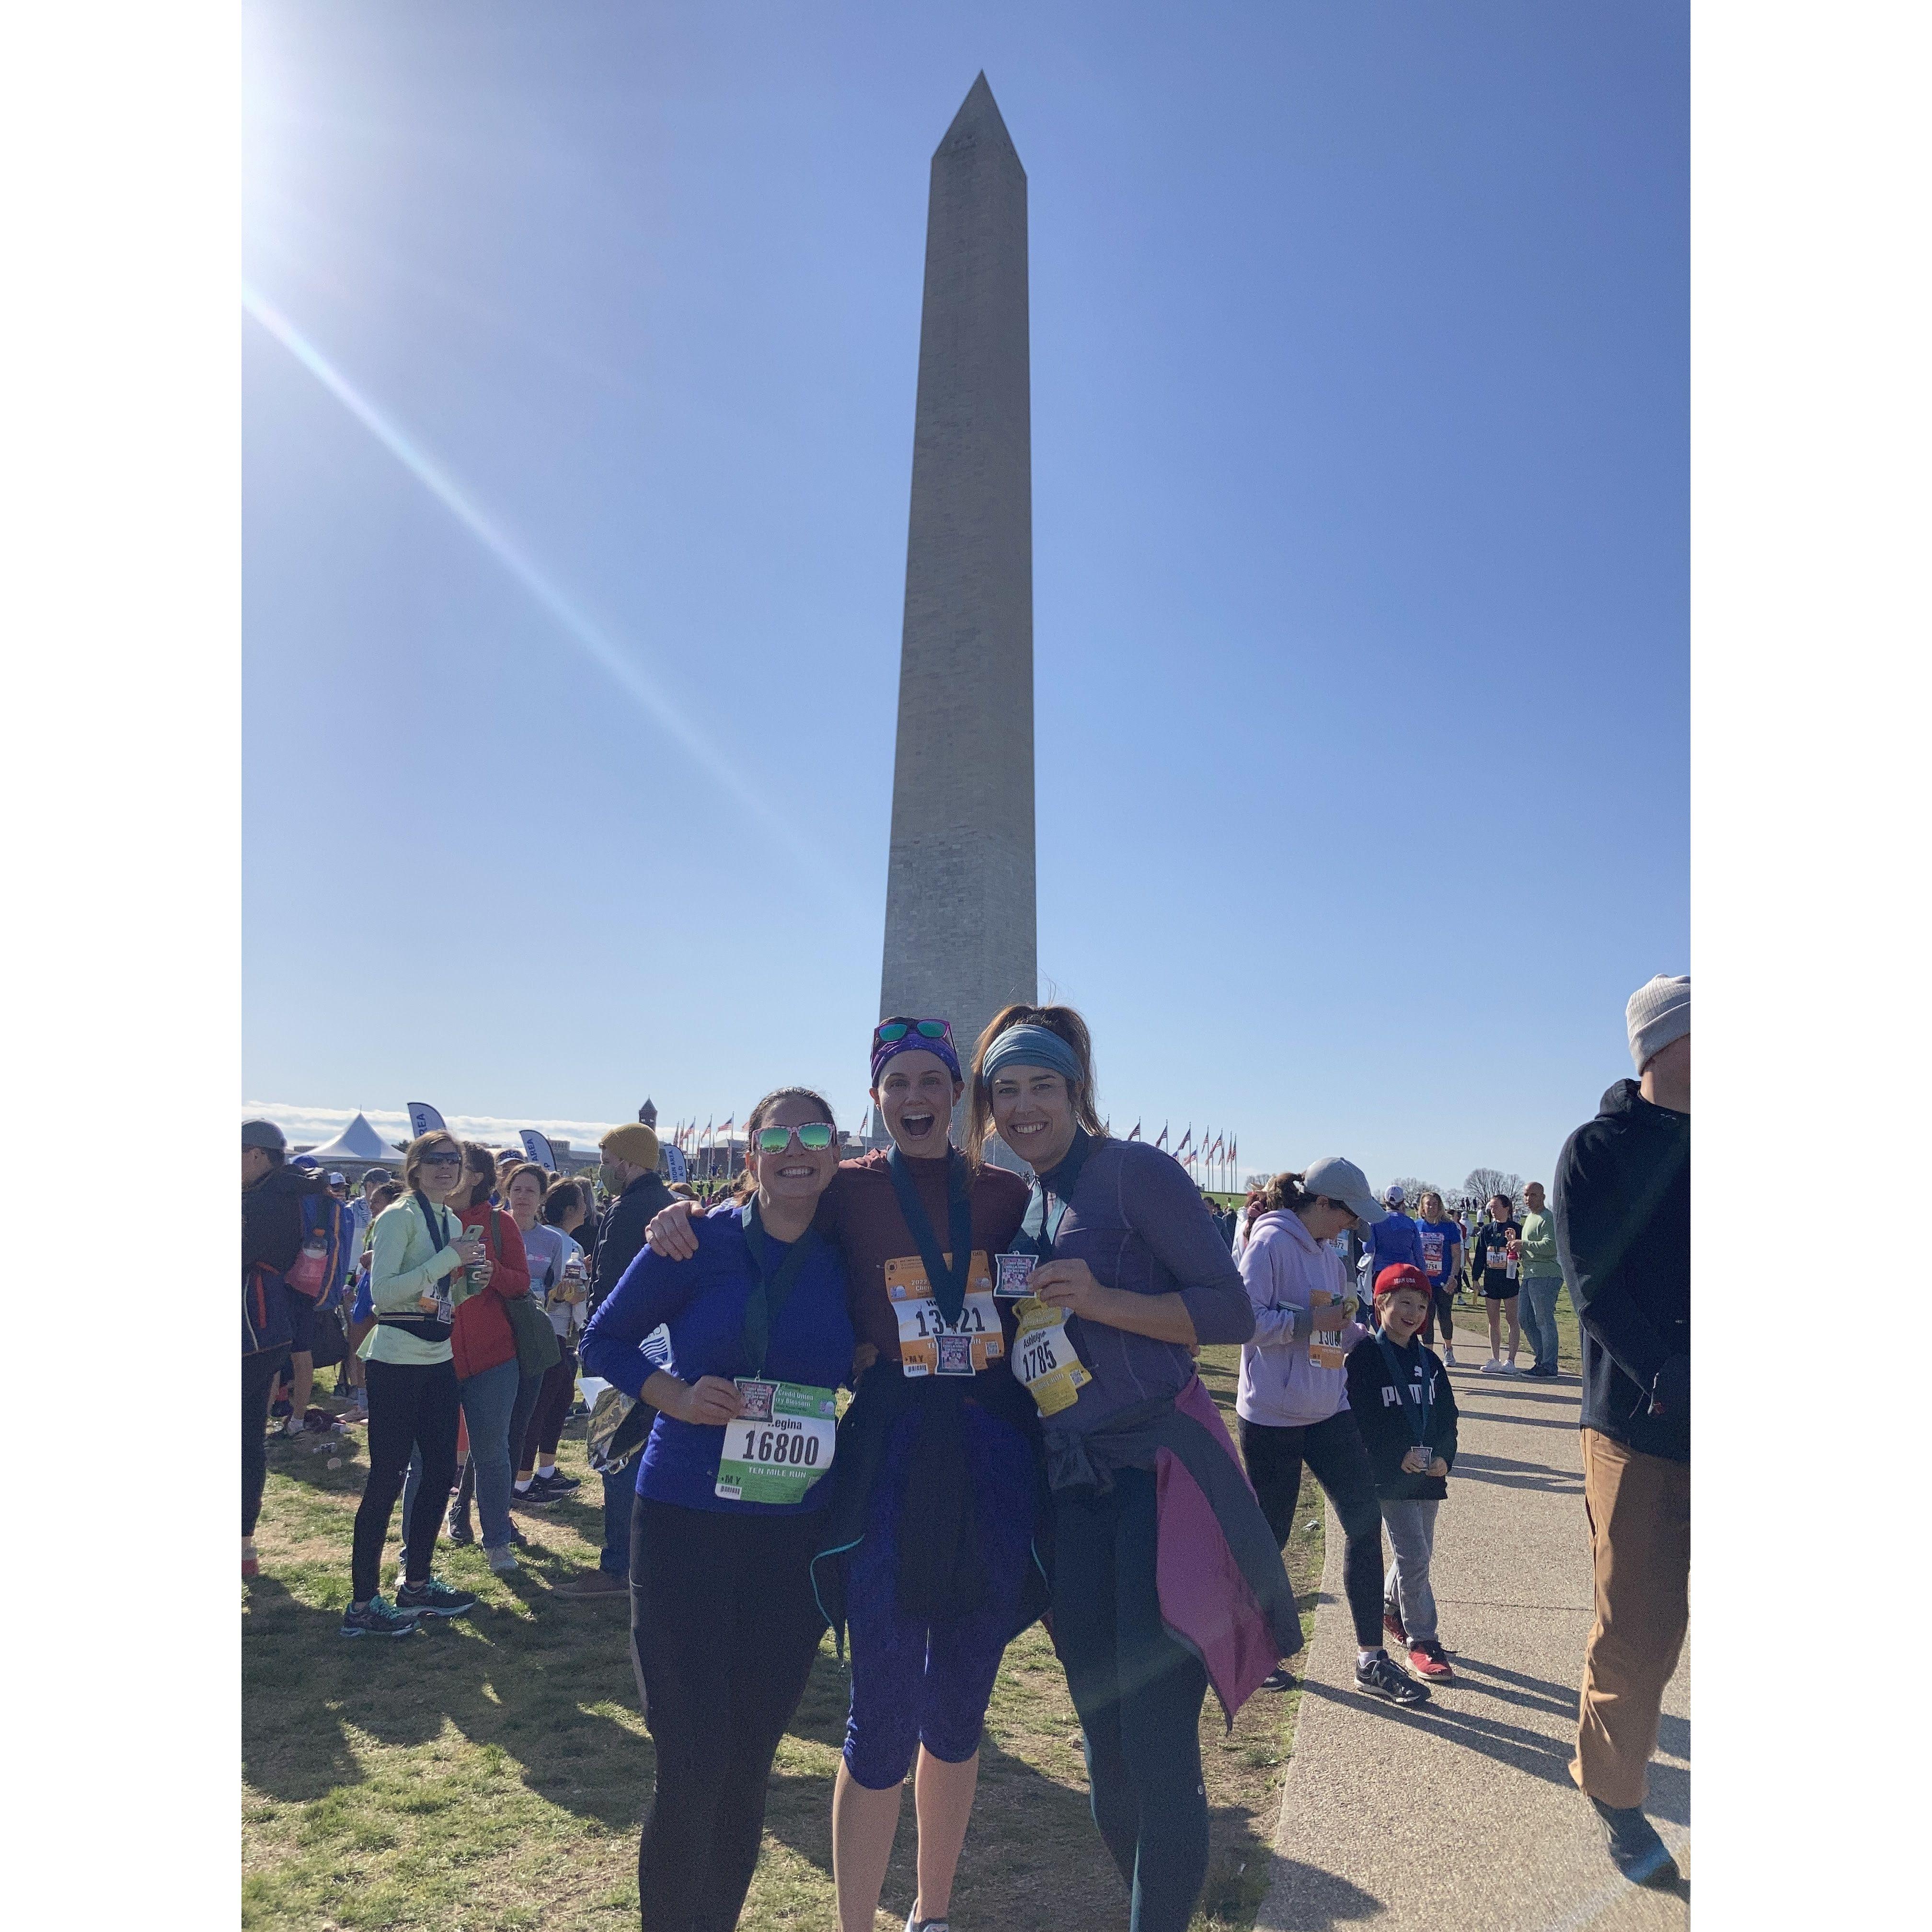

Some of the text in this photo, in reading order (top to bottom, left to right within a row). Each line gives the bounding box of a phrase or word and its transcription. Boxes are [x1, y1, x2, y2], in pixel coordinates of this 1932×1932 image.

[416, 1113, 427, 1136] REA
[527, 1138, 538, 1162] AREA
[915, 1307, 986, 1337] 1321
[1023, 1340, 1057, 1382] 1785
[786, 1398, 811, 1407] Blossom
[797, 1392, 814, 1401] Union
[768, 1418, 802, 1430] egina
[743, 1430, 819, 1466] 16800
[748, 1467, 806, 1478] TEN MILE RUN
